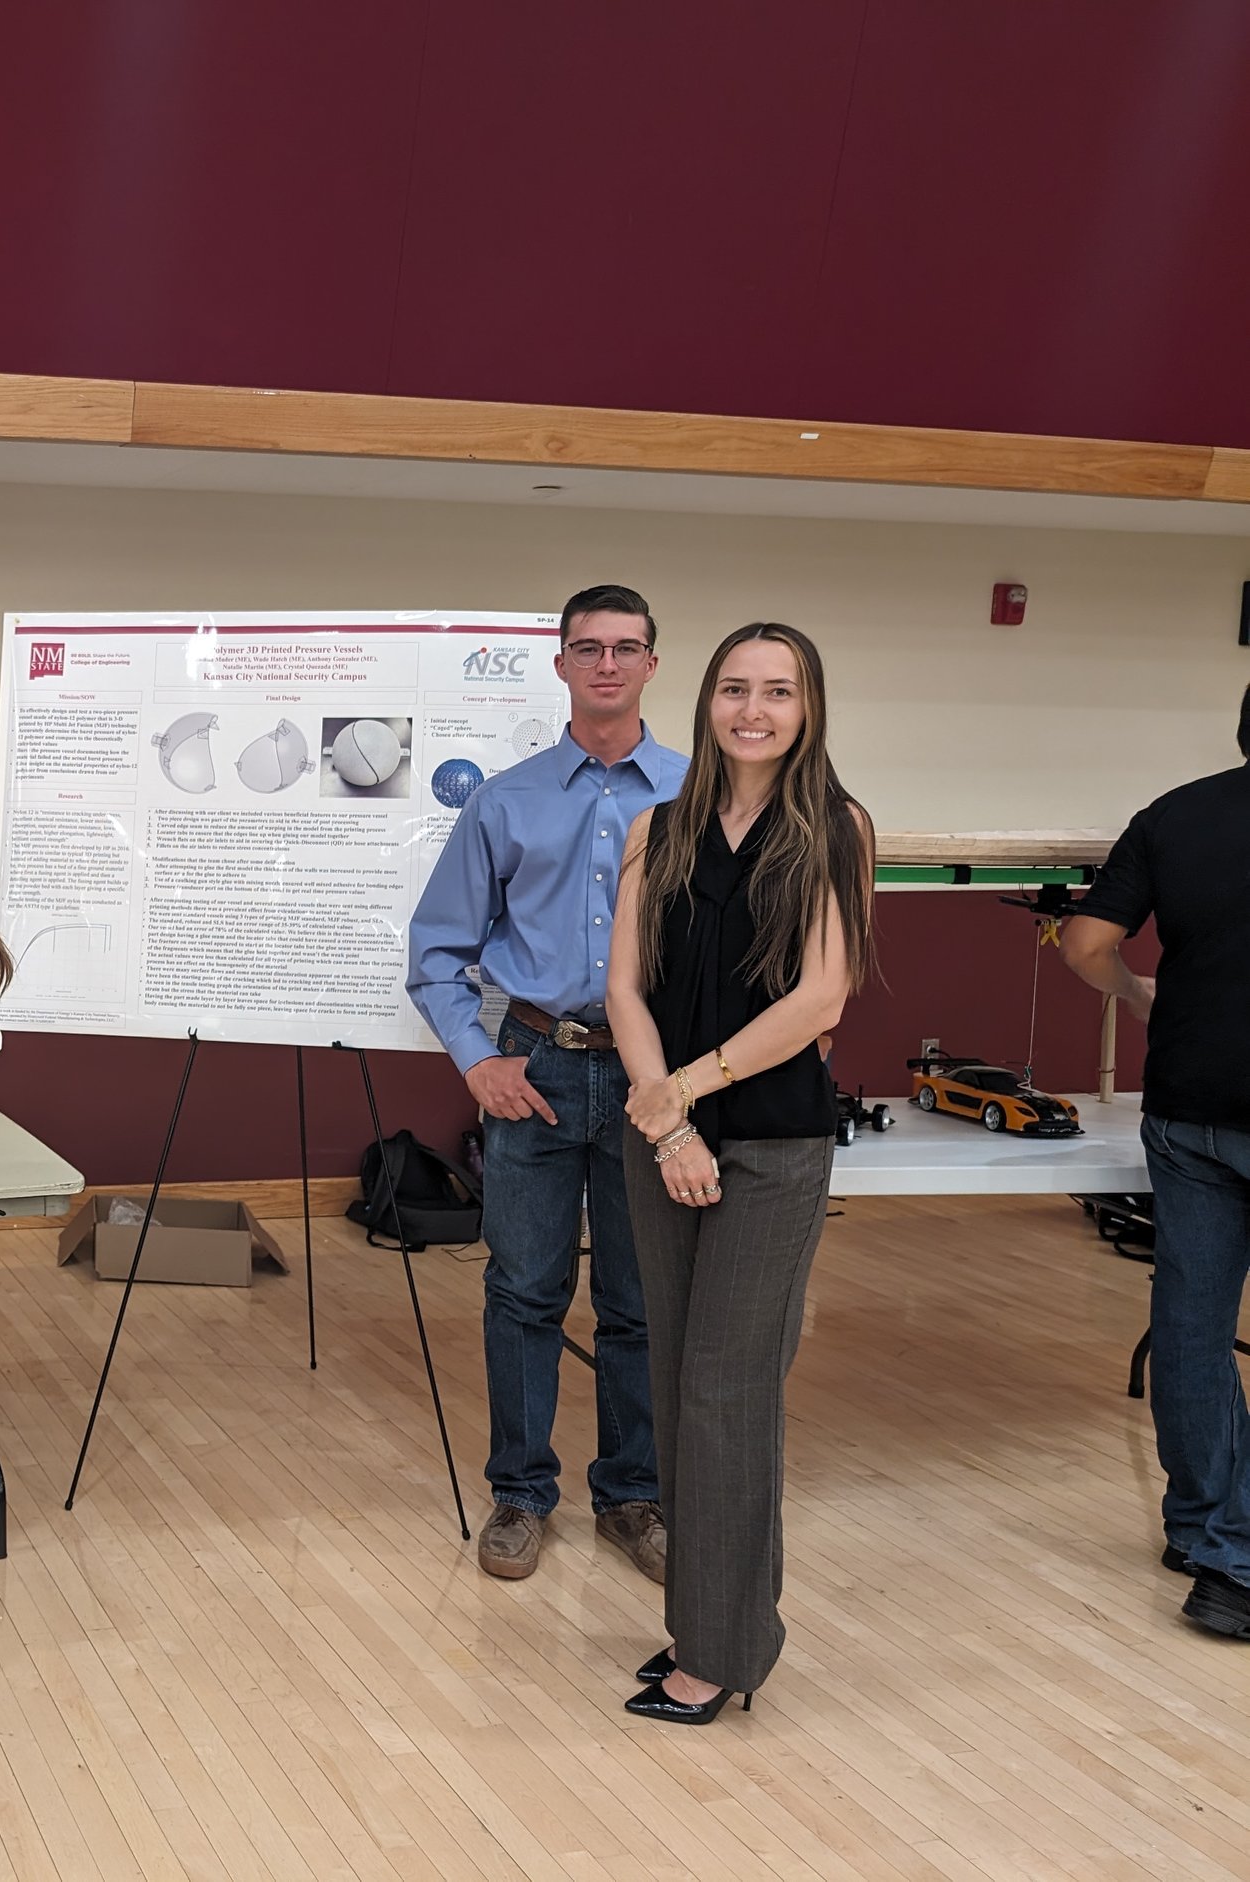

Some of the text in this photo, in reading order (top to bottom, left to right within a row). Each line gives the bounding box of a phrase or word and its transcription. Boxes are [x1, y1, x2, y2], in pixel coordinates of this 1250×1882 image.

[32, 647, 63, 662] NM
[214, 646, 244, 655] olymer
[246, 646, 259, 654] 3D
[261, 646, 292, 654] Printed
[334, 645, 363, 653] Vessels
[464, 652, 529, 676] NSC
[236, 673, 253, 682] City
[294, 673, 329, 682] Security
[332, 673, 367, 682] Campus
